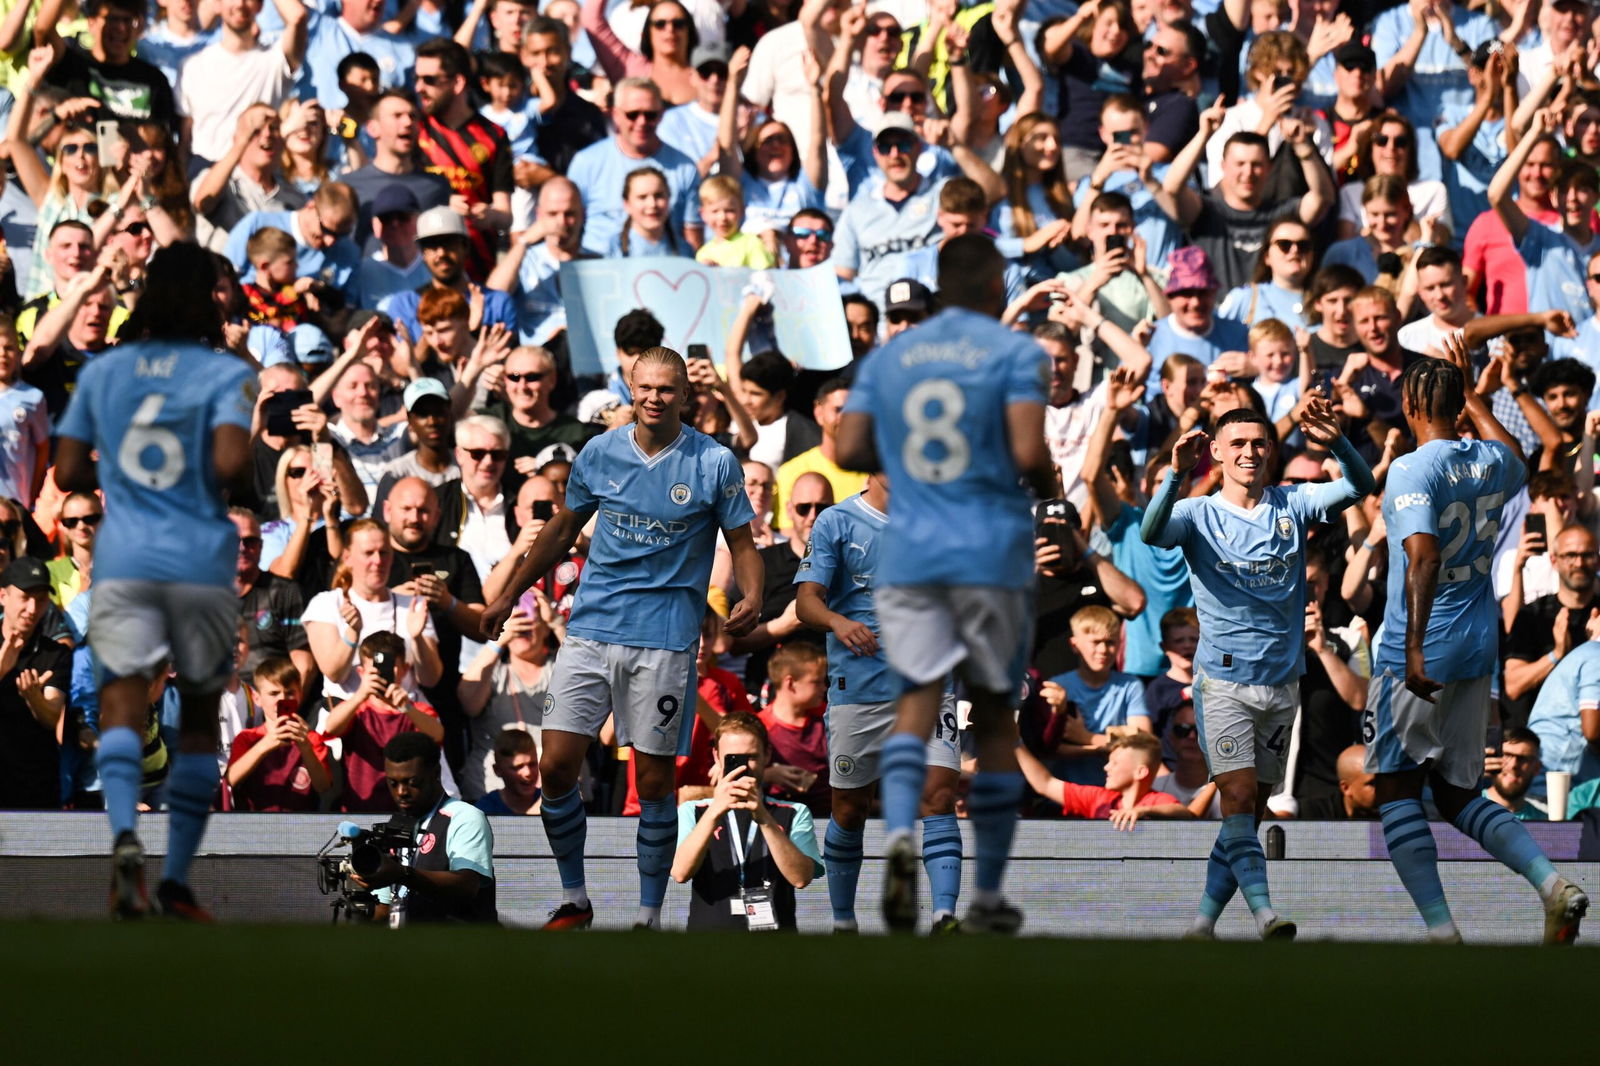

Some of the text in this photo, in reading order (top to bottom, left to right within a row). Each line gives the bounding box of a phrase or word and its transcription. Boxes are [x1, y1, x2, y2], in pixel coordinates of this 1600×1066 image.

[117, 393, 186, 492] 6
[902, 377, 972, 485] 8
[602, 509, 688, 533] ETIHAD
[611, 527, 671, 546] AIRWAYS
[1437, 490, 1505, 585] 25
[656, 694, 679, 727] 9
[935, 711, 958, 743] 19
[1265, 724, 1293, 756] 4
